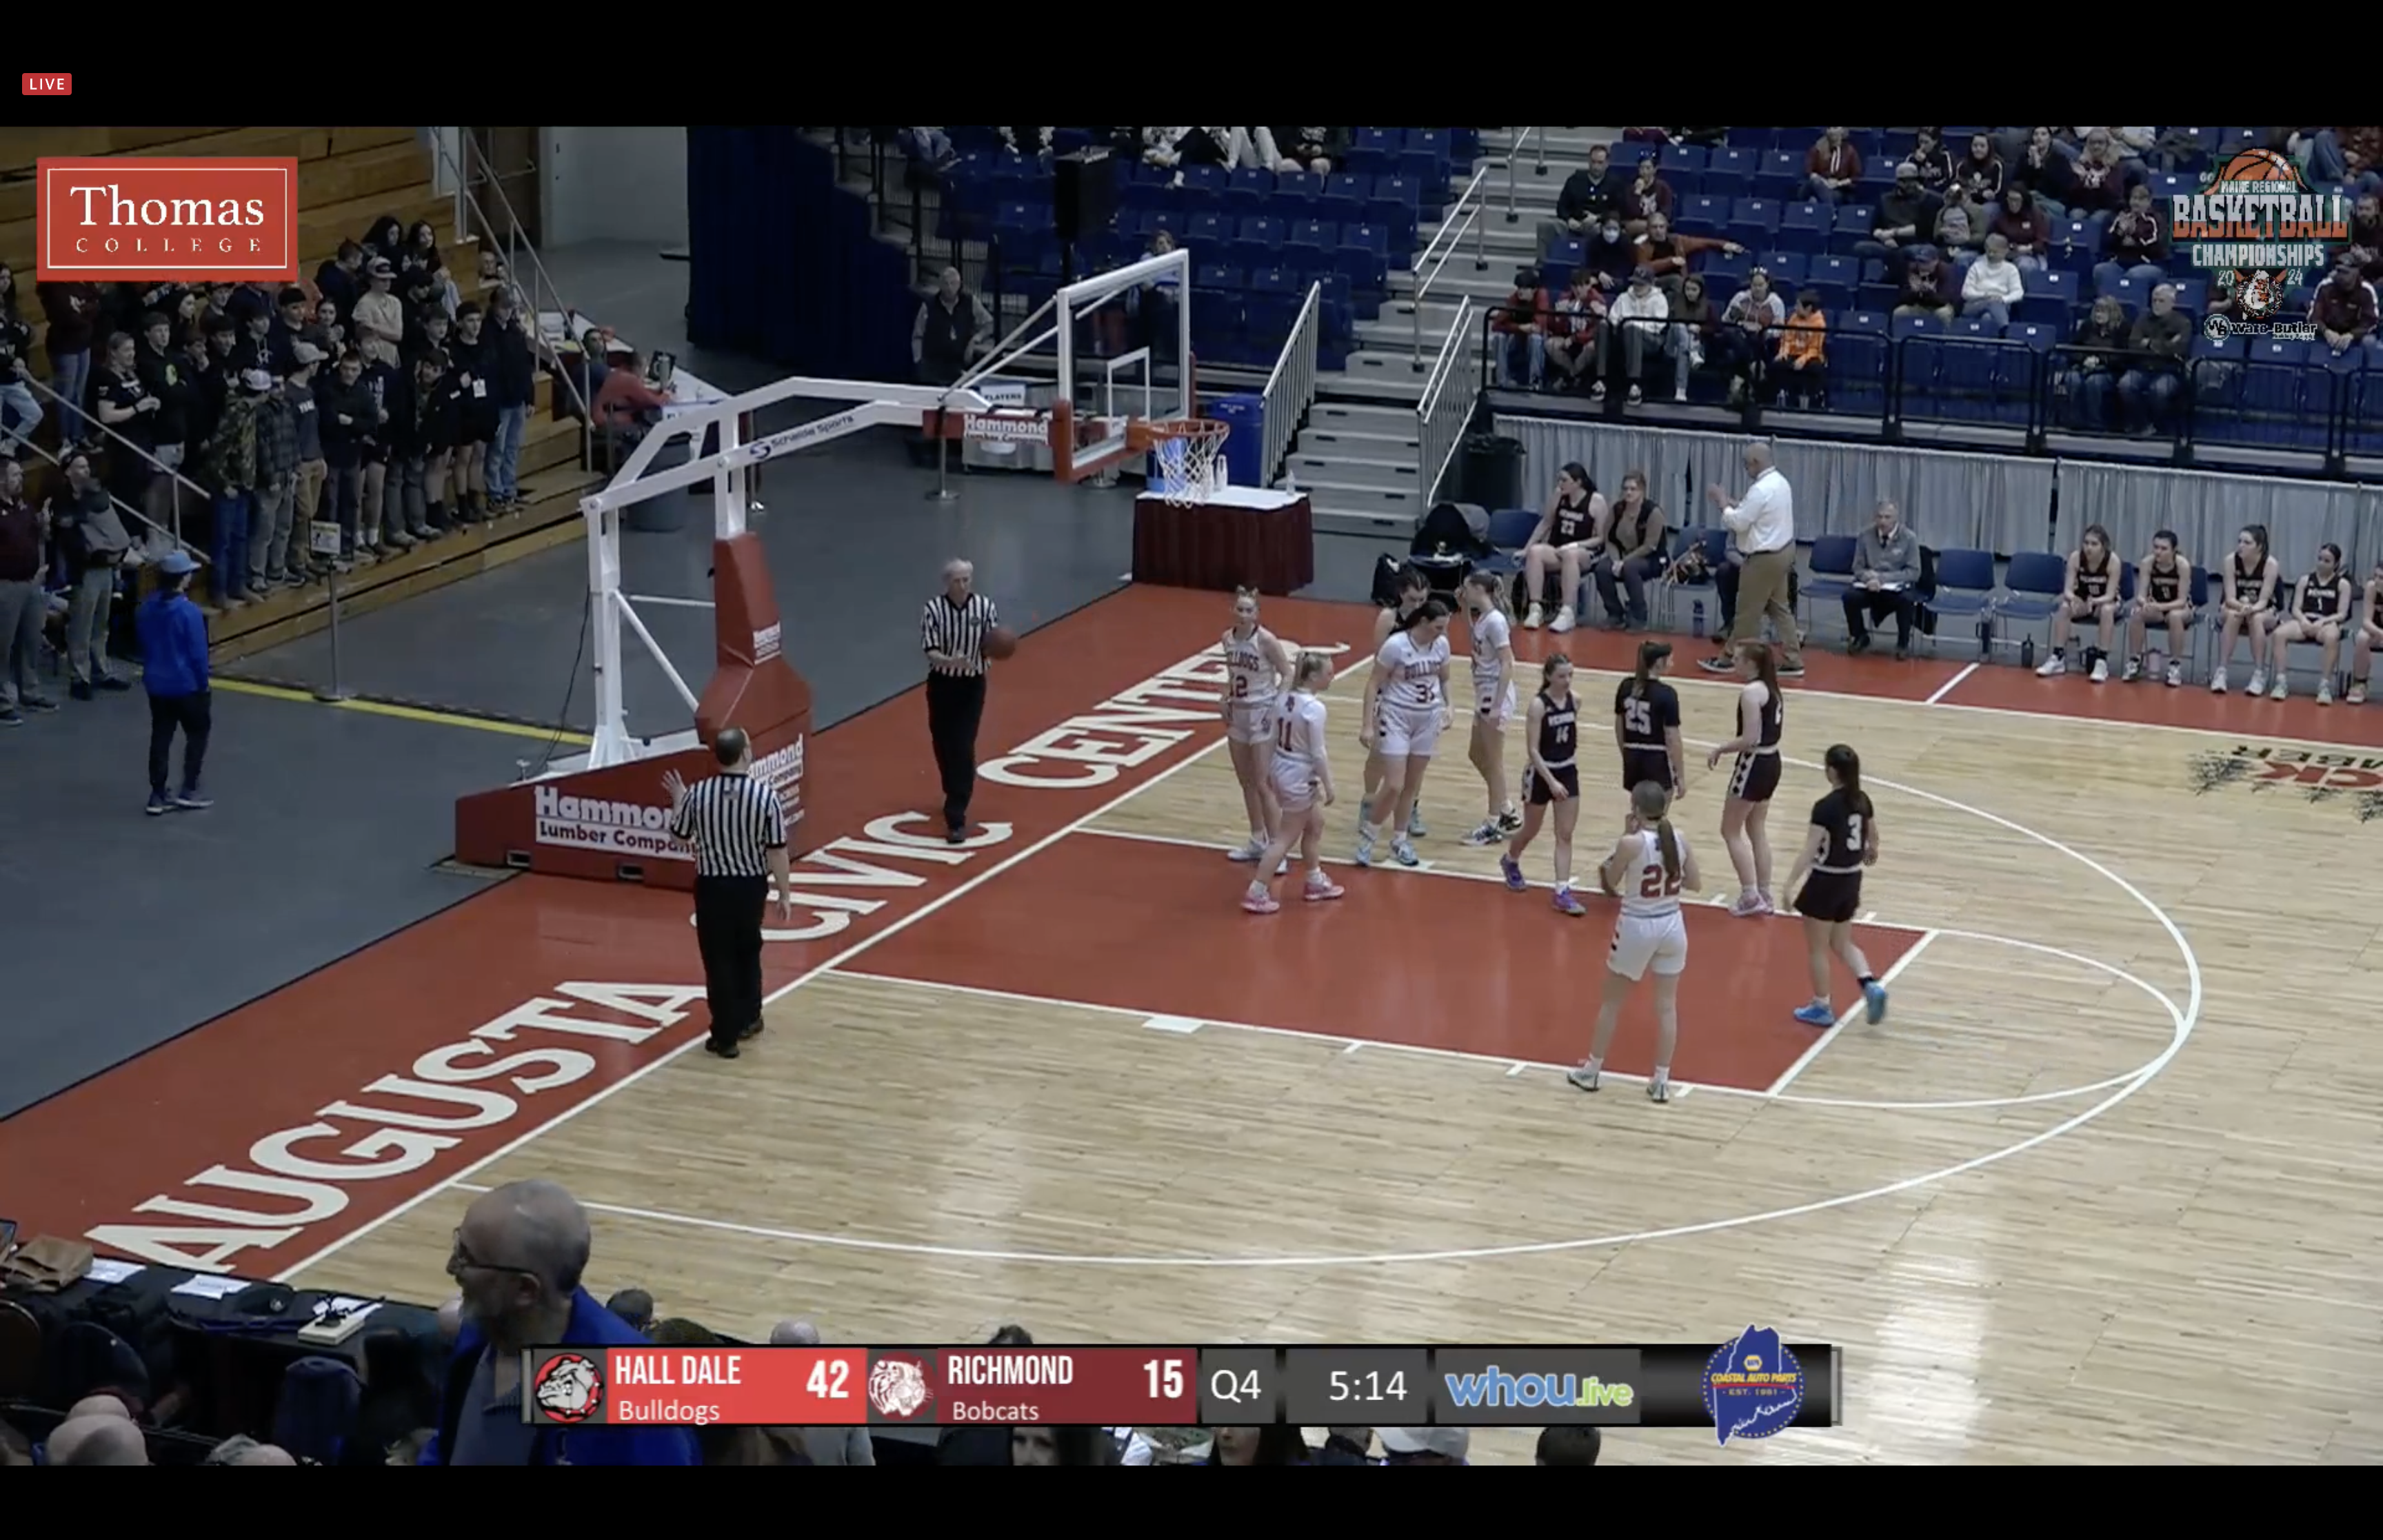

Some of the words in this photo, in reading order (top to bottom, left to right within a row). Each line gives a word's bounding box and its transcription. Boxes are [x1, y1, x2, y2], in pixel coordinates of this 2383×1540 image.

[964, 413, 1048, 433] Hammond
[1278, 717, 1293, 753] 11
[1624, 697, 1651, 736] 25
[748, 733, 803, 780] ammond
[534, 785, 672, 830] Hammo
[540, 820, 607, 843] Lumber
[1847, 813, 1862, 851] 3
[1640, 864, 1681, 898] 22
[84, 980, 709, 1274] AUGUSTA
[690, 811, 1014, 942] CIVIC
